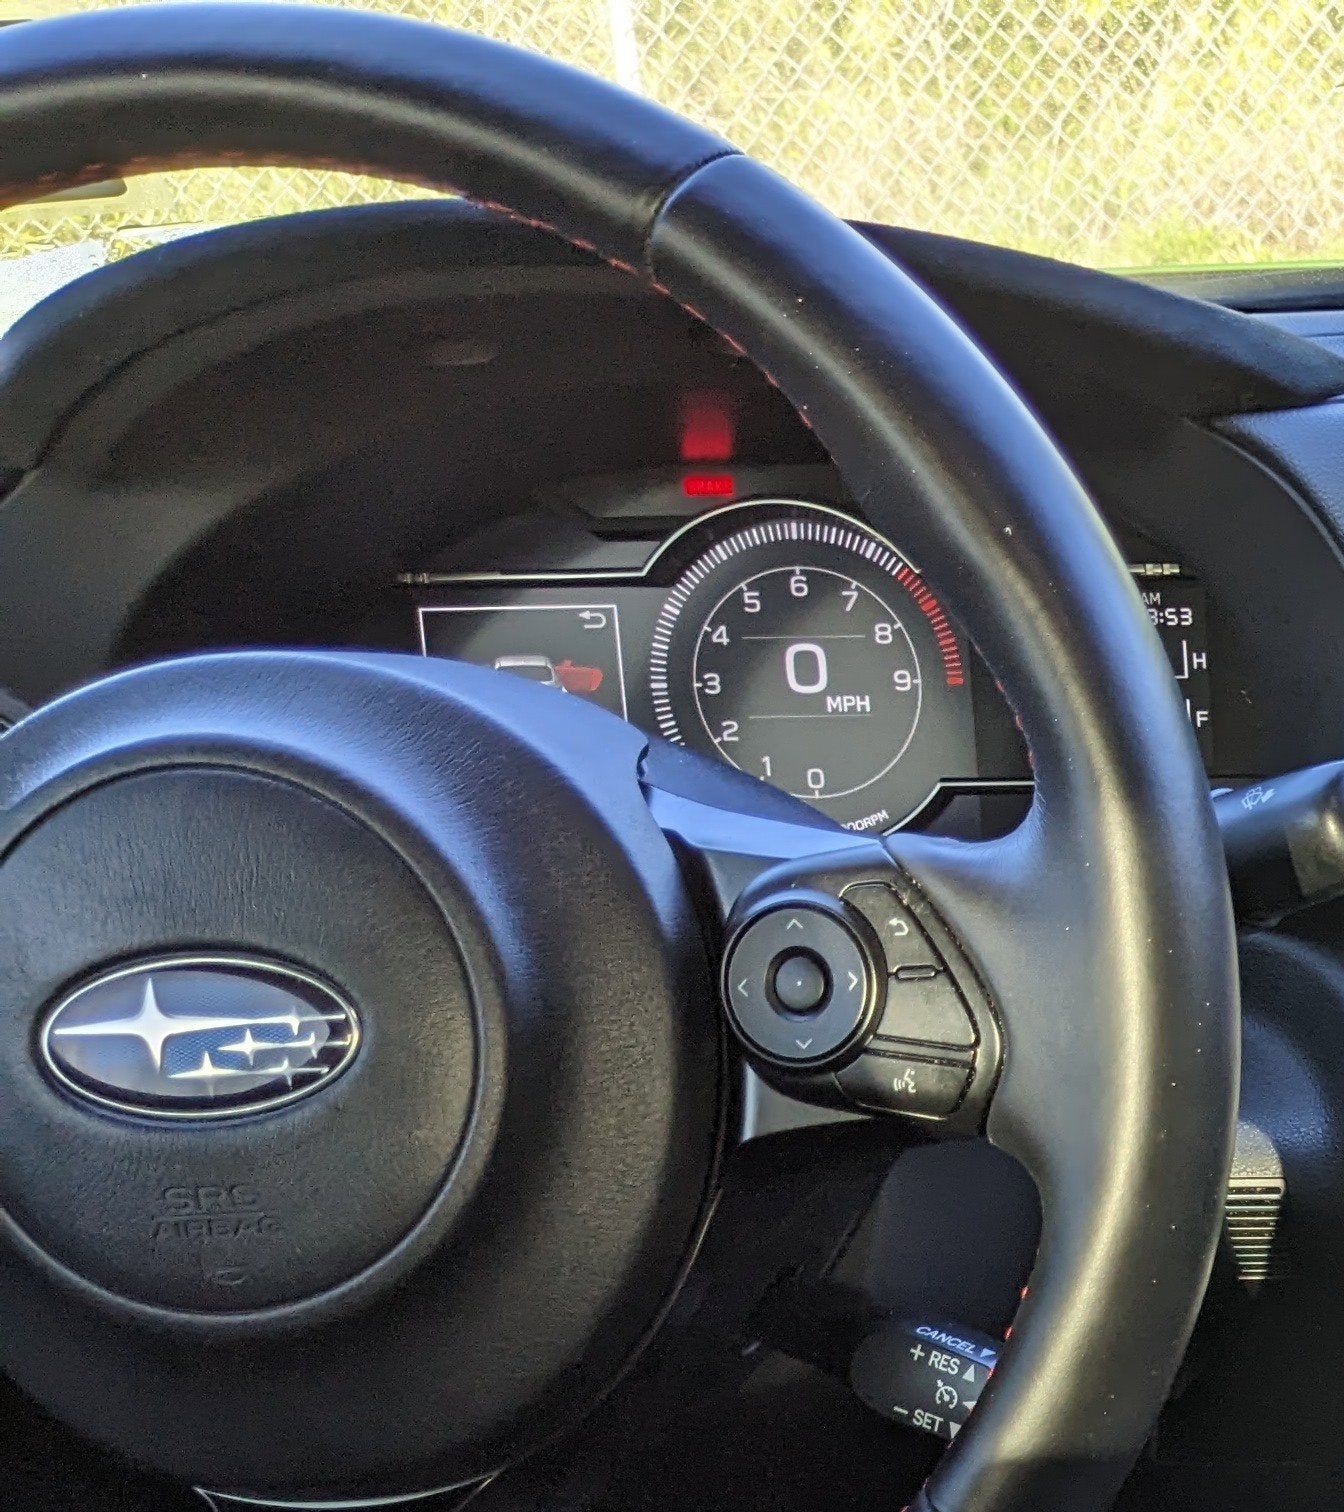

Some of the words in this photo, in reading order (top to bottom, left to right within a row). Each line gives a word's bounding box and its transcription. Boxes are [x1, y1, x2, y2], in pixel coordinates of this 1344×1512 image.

[790, 576, 809, 597] 6
[743, 592, 761, 613] 5
[842, 590, 859, 612] 7
[711, 625, 730, 646] 4
[874, 623, 893, 644] 8
[785, 643, 828, 694] 0
[1193, 653, 1207, 669] H
[703, 673, 721, 695] 3
[893, 670, 912, 692] 9
[826, 695, 871, 713] MPH
[1196, 711, 1209, 727] F
[721, 721, 739, 742] 2
[760, 756, 772, 777] 1
[807, 768, 825, 789] 0
[916, 1326, 976, 1354] CANCEL
[928, 1350, 960, 1375] RES
[913, 1409, 944, 1432] SET
